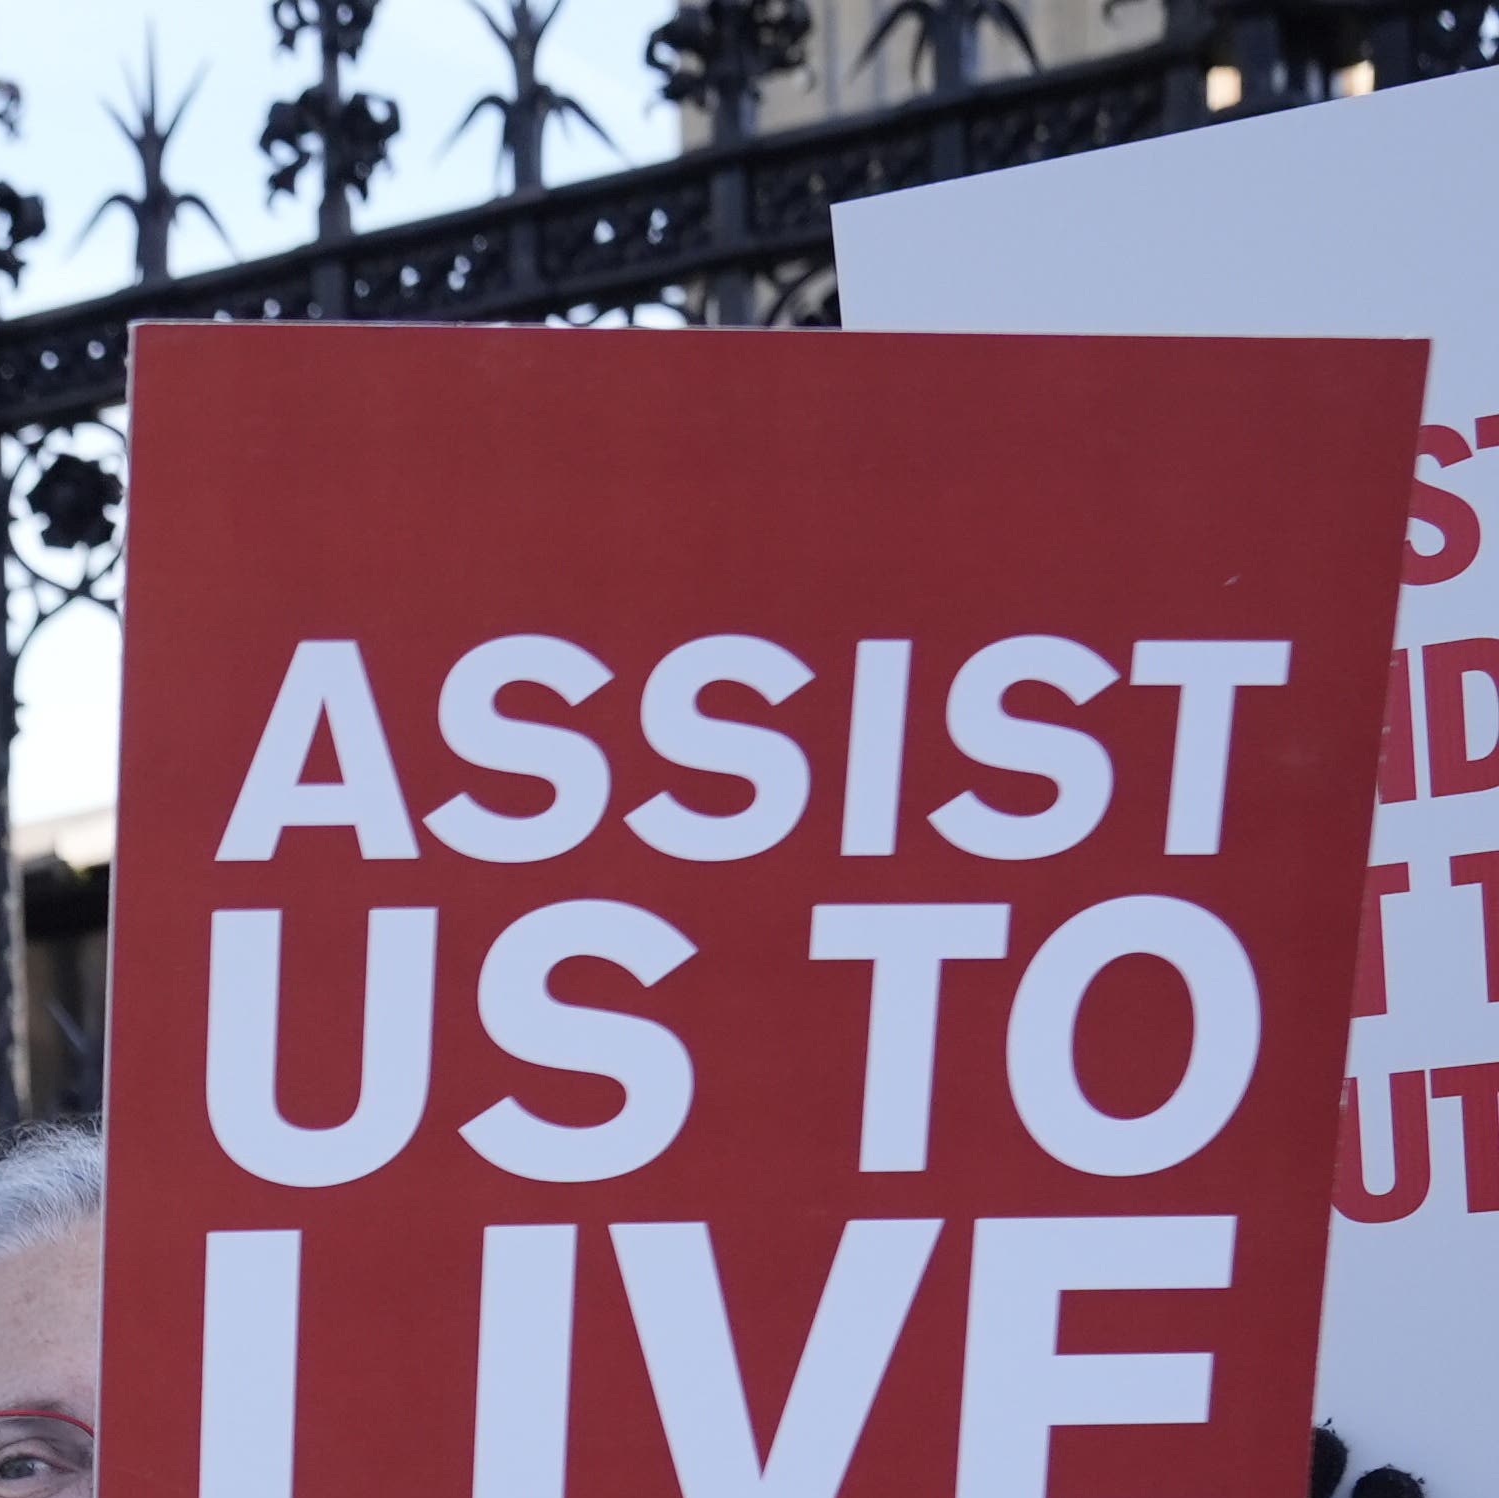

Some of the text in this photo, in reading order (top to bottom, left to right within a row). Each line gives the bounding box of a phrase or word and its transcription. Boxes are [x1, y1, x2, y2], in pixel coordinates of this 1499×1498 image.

[214, 634, 1292, 864] ASSIST
[205, 894, 1262, 1188] US TO
